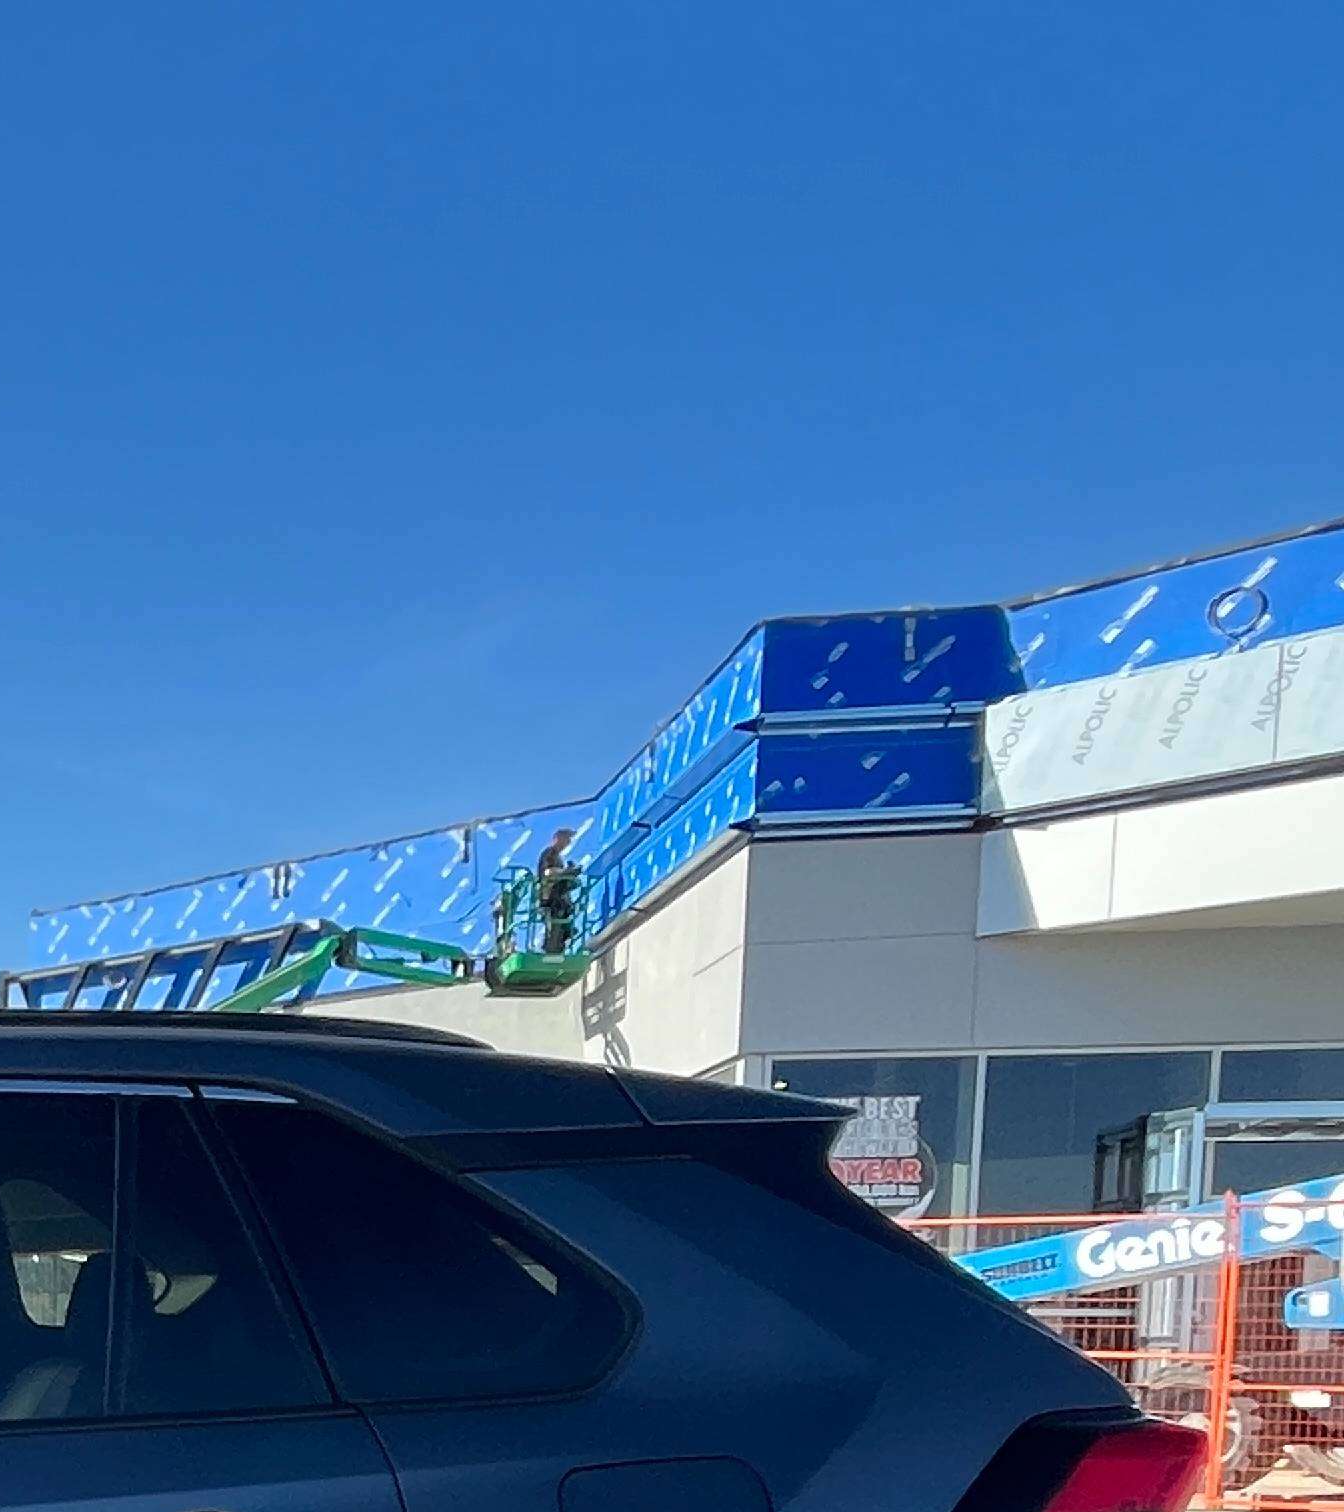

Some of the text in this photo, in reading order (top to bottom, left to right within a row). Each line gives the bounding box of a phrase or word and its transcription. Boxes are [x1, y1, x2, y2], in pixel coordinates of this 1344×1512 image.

[1158, 667, 1208, 750] ALPOLIC
[1249, 645, 1308, 732] ALPOLIC
[1072, 685, 1118, 765] ALPOLIC
[863, 1096, 921, 1119] BEST
[845, 1158, 922, 1183] YEAR
[1076, 1218, 1226, 1278] Genie
